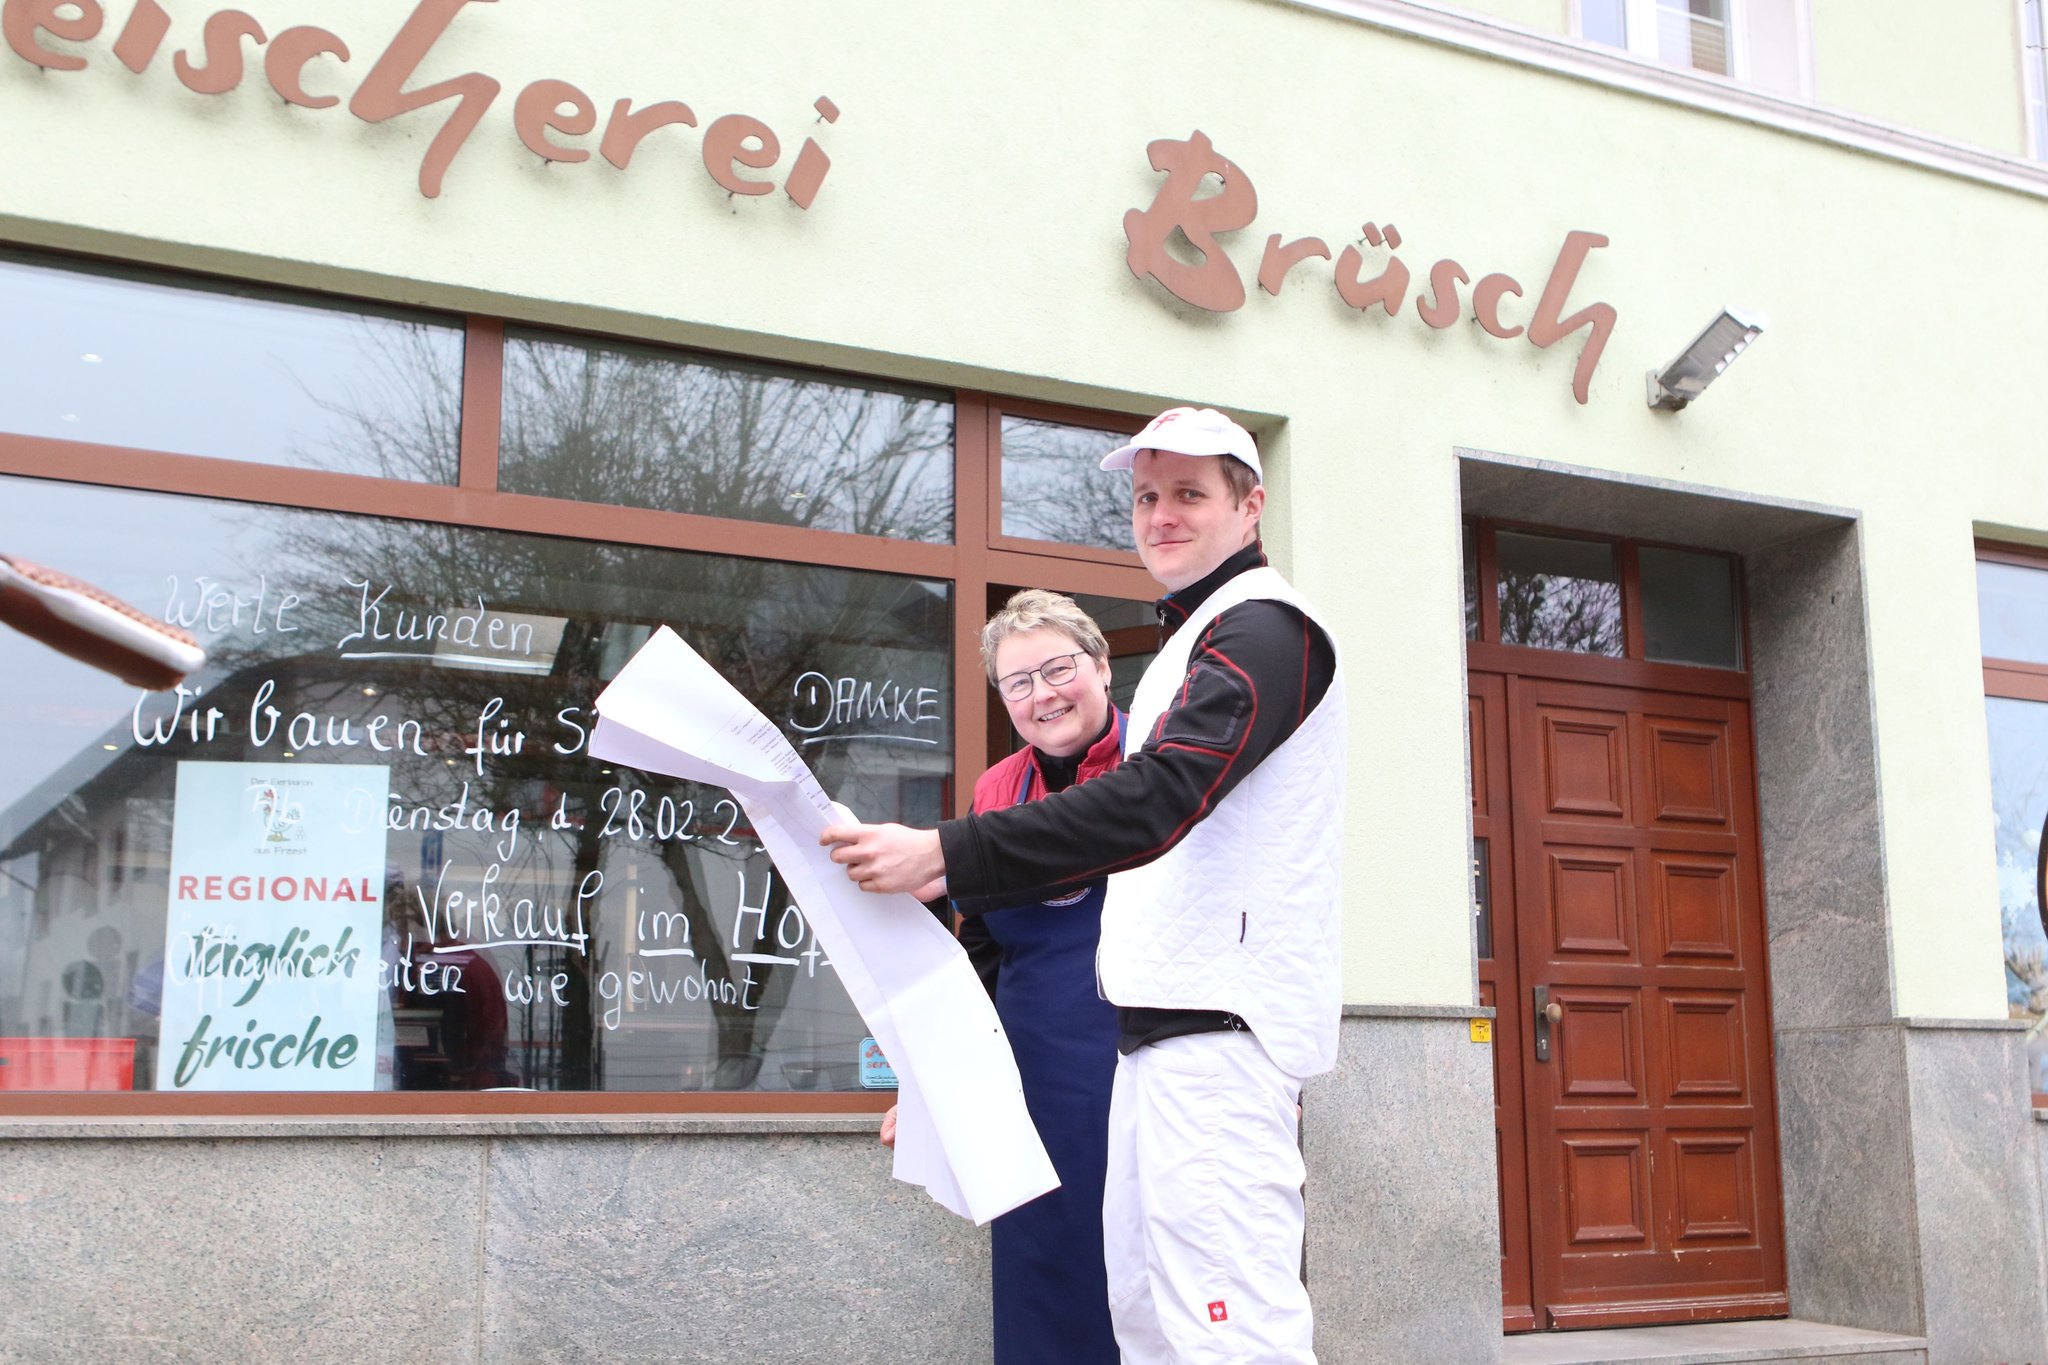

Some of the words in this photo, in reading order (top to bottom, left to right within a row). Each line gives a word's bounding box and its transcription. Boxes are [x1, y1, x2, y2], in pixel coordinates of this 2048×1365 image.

[1123, 130, 1617, 404] Brüsch
[164, 575, 300, 635] Werte
[337, 577, 534, 655] Kunden
[133, 683, 223, 746] Wir
[250, 679, 428, 756] bauen
[466, 697, 525, 777] für
[553, 706, 598, 754] Si
[789, 671, 940, 732] DANKE
[551, 792, 585, 831] d.
[597, 786, 766, 852] 28.02.2
[177, 875, 378, 903] REGIONAL
[416, 859, 604, 956] Verkauf
[638, 888, 691, 944] im
[185, 926, 361, 1007] täglich
[504, 967, 570, 1007] wie
[599, 959, 760, 1031] gewohnt
[173, 1014, 359, 1088] frische
